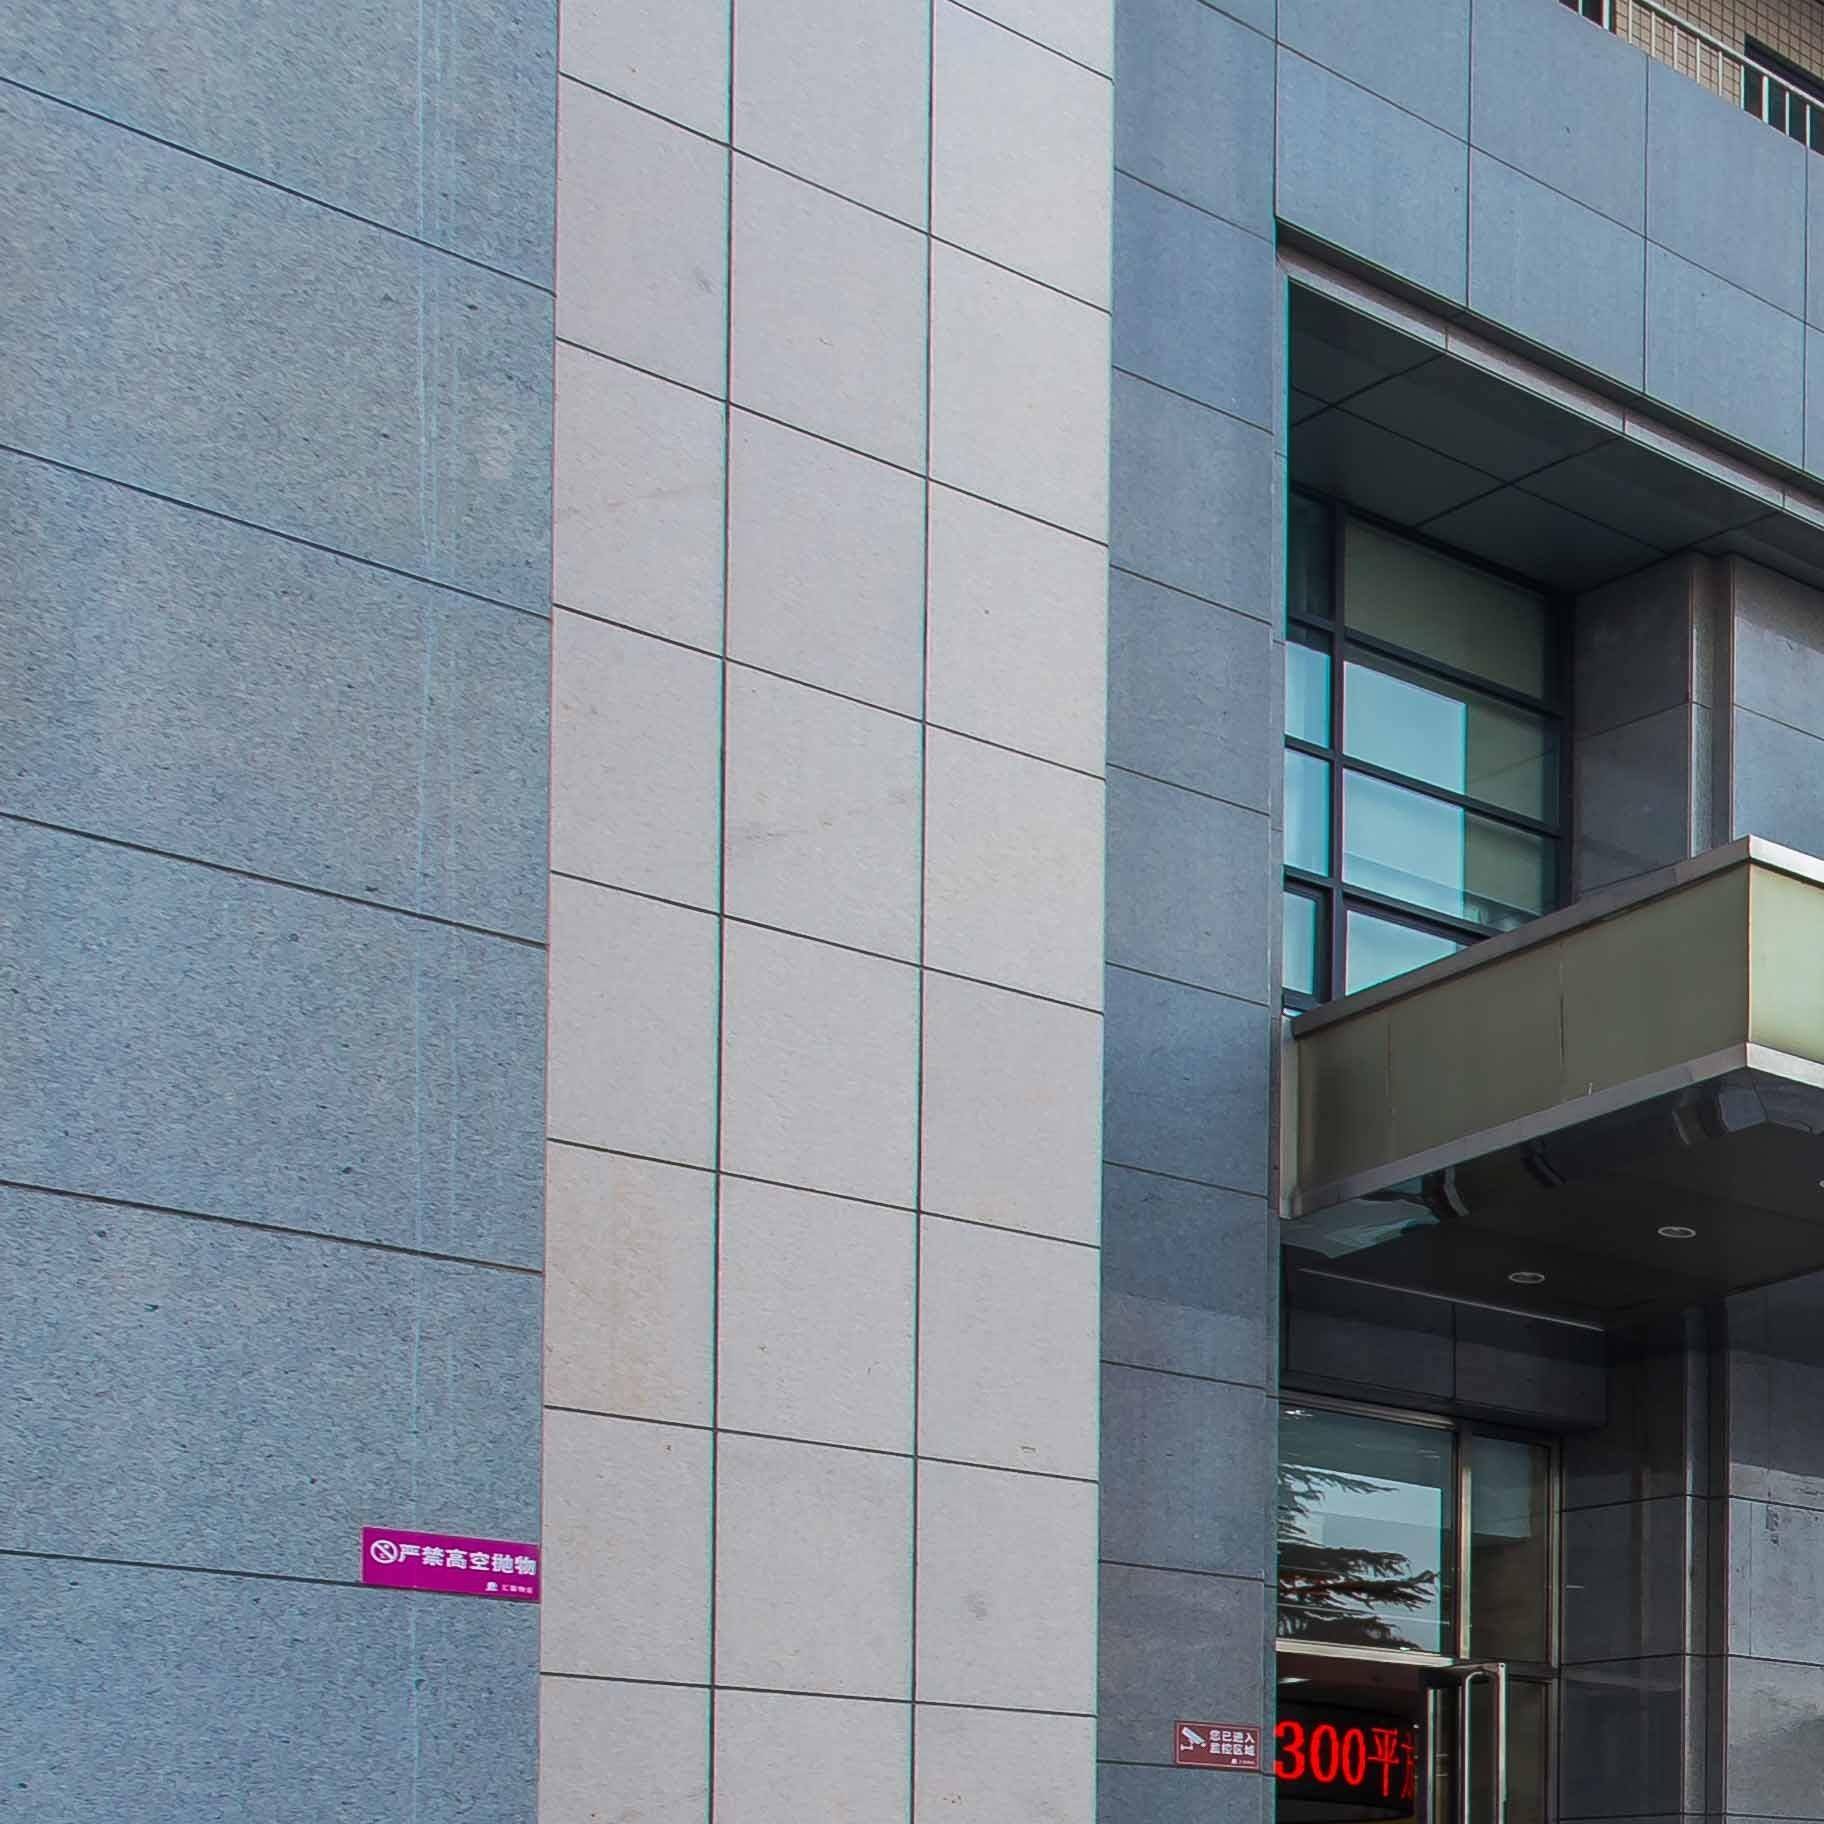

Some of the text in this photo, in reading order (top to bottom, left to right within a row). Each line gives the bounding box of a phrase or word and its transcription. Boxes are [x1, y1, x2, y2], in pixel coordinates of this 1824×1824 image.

[398, 1543, 537, 1576] 严禁高空抛物
